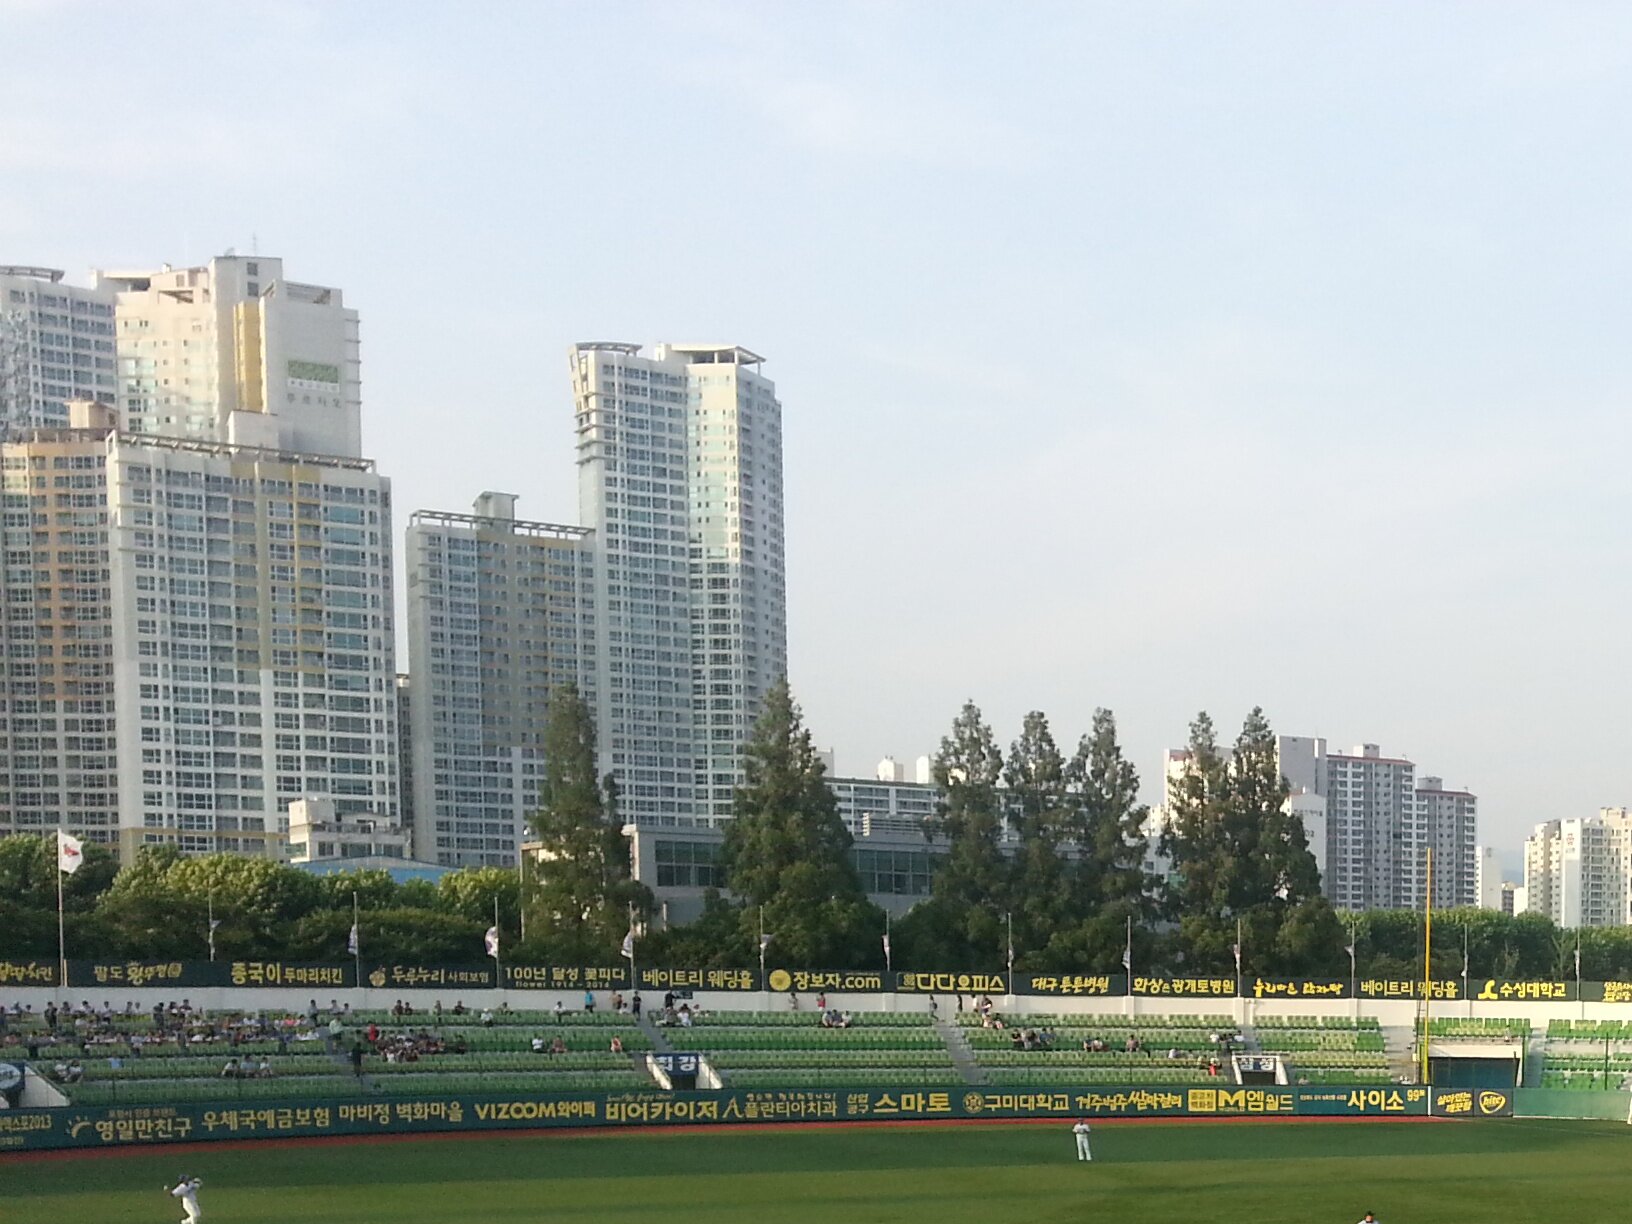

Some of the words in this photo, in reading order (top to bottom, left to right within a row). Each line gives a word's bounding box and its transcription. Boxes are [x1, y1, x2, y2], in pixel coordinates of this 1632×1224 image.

[284, 968, 343, 984] 두마리치킨
[391, 965, 445, 985] 두루누리
[448, 970, 489, 983] 사회보험
[505, 966, 546, 981] 100년
[552, 967, 579, 981] 달성
[707, 970, 754, 989] 웨딩홀
[793, 971, 881, 991] 장보자.com
[1031, 977, 1059, 992] 대구
[1172, 978, 1235, 994] 광개토병원
[1500, 982, 1567, 999] 수성대학교
[745, 1101, 837, 1118] 플란티아치과
[873, 1093, 952, 1114] 스마토
[984, 1094, 1070, 1112] 구미대학교
[1247, 1091, 1294, 1112] 엠월드
[1348, 1090, 1405, 1111] 사이소
[338, 1103, 390, 1124] 마비정
[396, 1101, 464, 1123] 벽화마을
[605, 1101, 718, 1122] 비어카이저
[95, 1117, 192, 1141] 영일만친구
